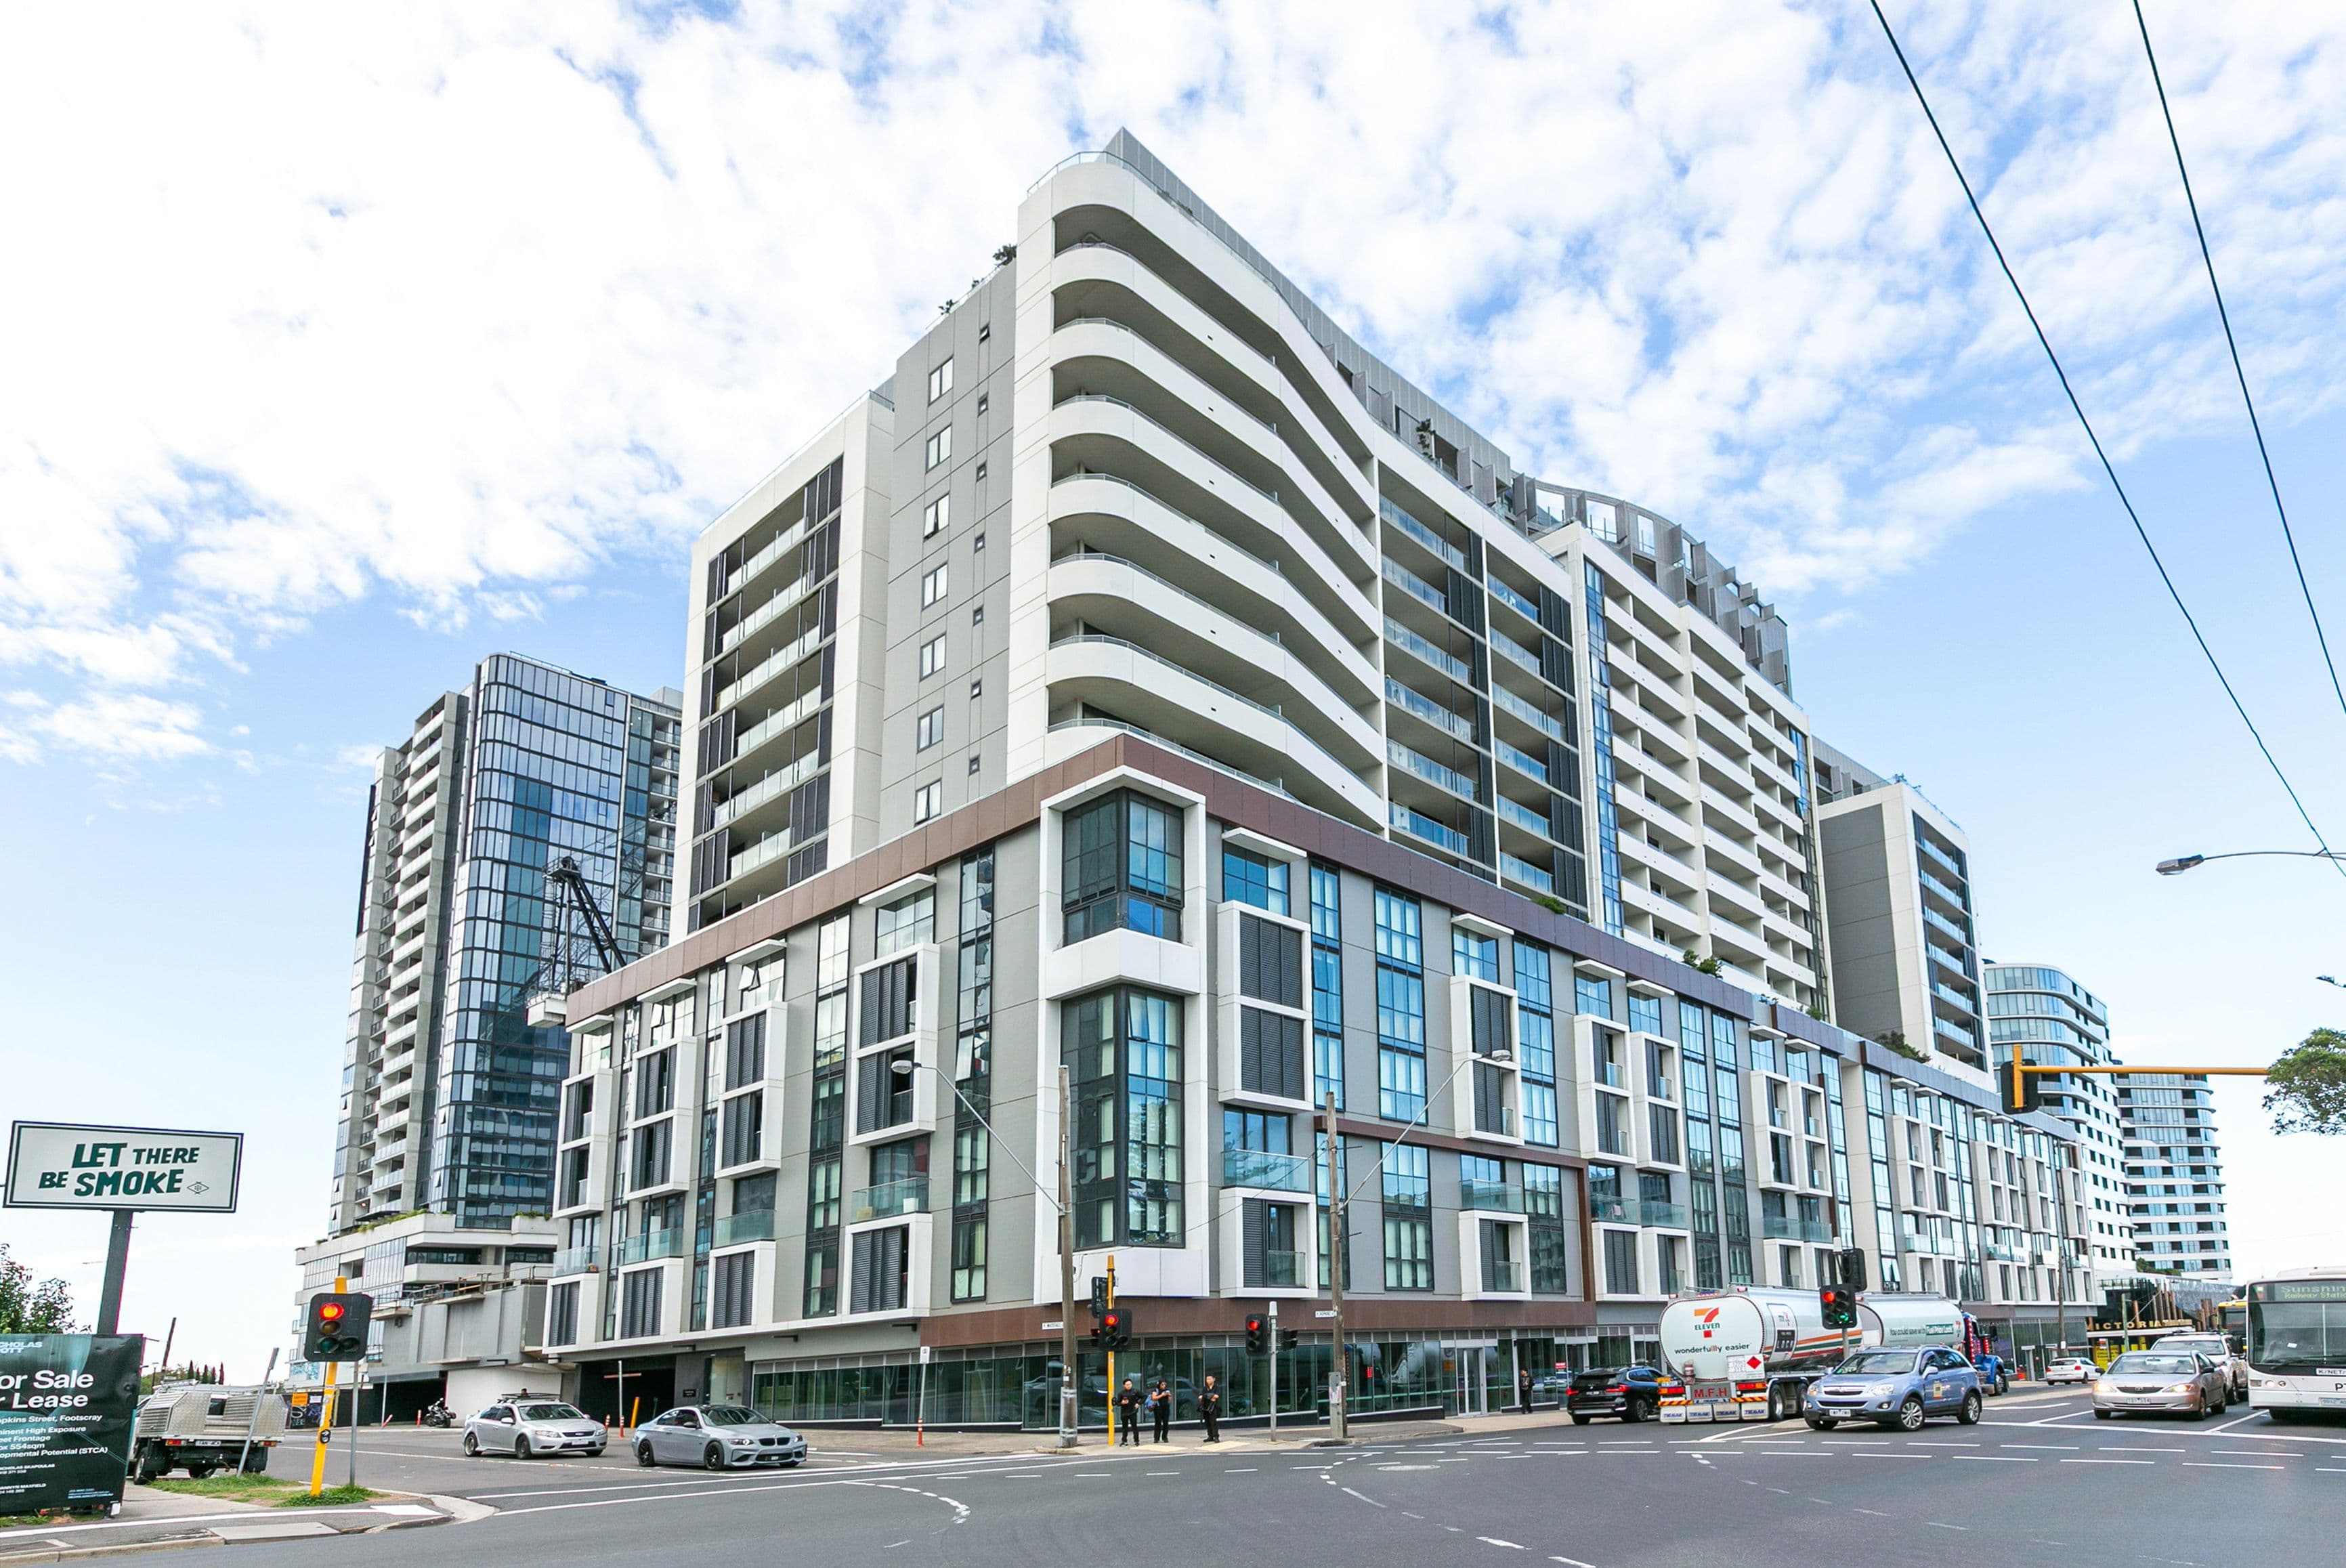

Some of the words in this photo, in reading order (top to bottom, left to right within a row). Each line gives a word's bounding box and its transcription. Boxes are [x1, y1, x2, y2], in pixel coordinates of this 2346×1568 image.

[71, 1143, 128, 1168] LET
[133, 1147, 200, 1164] THERE
[38, 1171, 68, 1189] BE
[74, 1169, 184, 1196] SMOKE
[1725, 1343, 1750, 1351] easier
[33, 1370, 94, 1389] Sale
[12, 1393, 88, 1409] Lease
[0, 1416, 26, 1424] pkins
[41, 1448, 78, 1456] Potential
[79, 1446, 108, 1454] (STCA)
